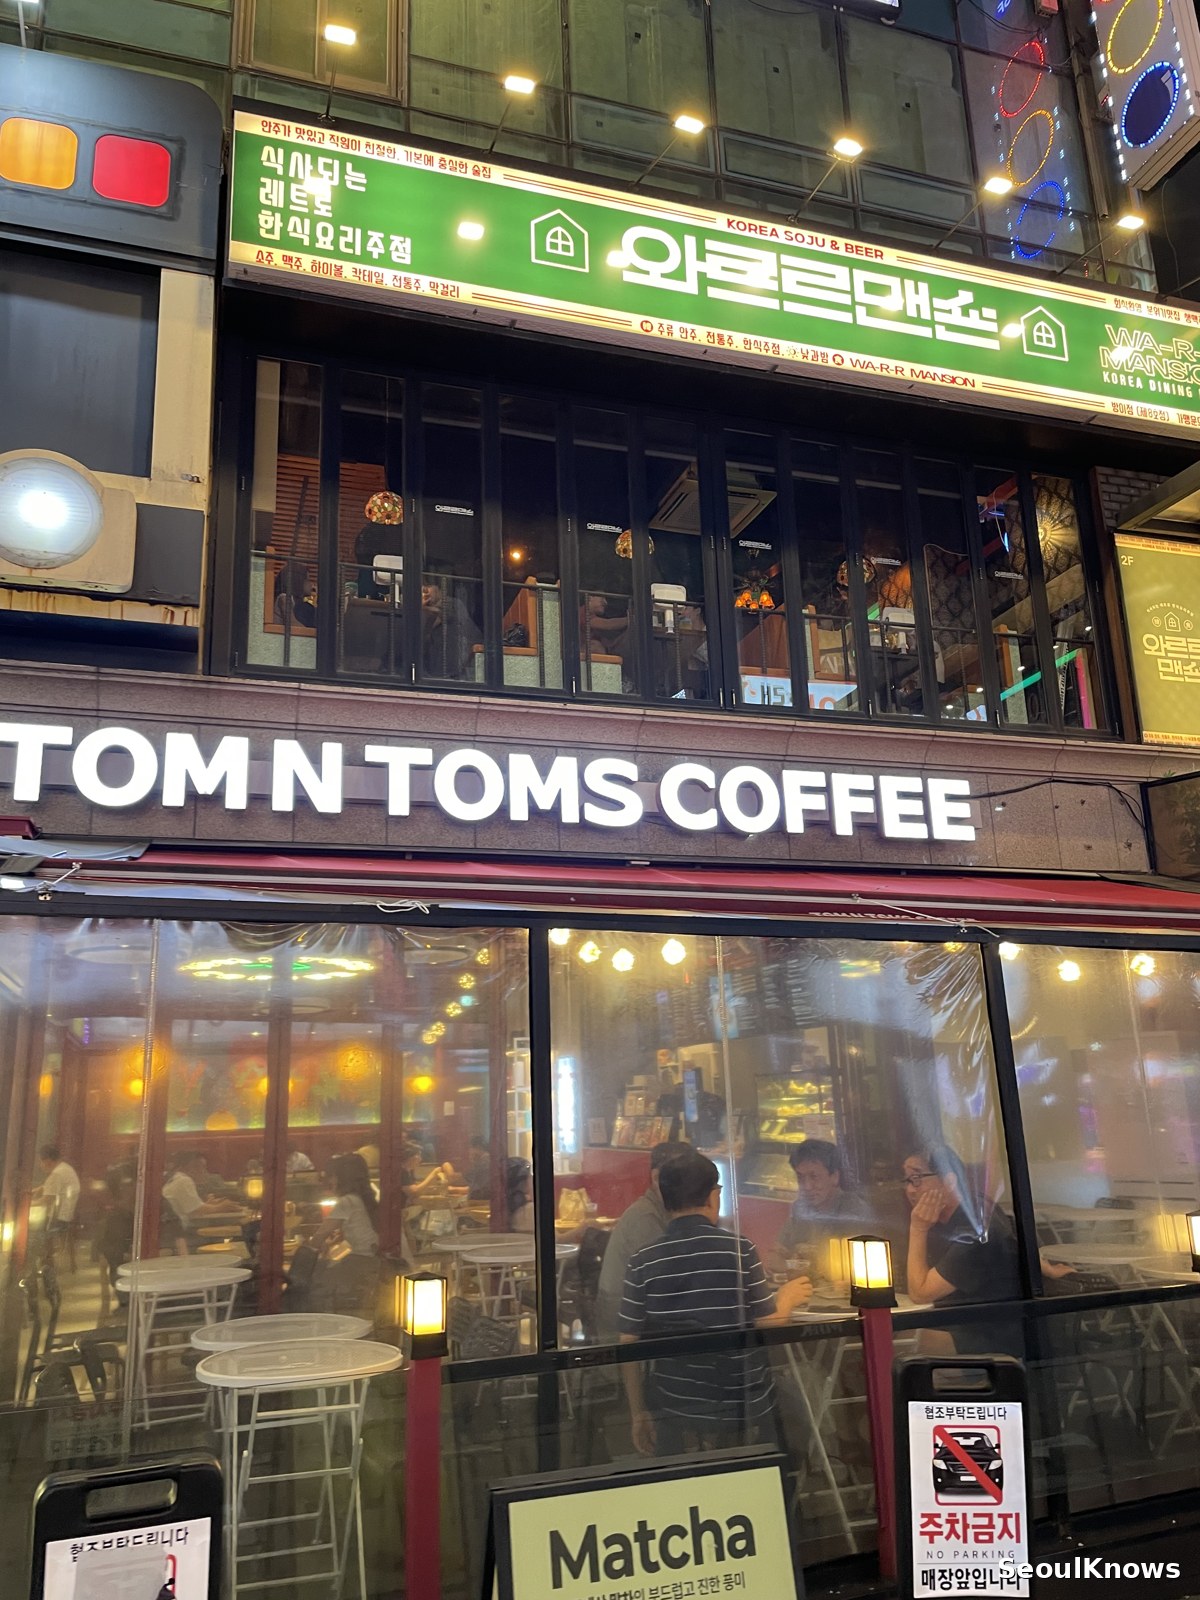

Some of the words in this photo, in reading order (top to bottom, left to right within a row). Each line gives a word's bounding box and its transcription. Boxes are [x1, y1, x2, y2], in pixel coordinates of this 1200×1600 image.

[261, 120, 291, 137] 안주가
[295, 127, 325, 144] 맛있고
[329, 133, 361, 152] 직원이
[404, 150, 434, 167] 기본에
[438, 157, 468, 174] 충실한
[472, 164, 491, 179] 술집
[261, 145, 367, 192] 식사되는
[259, 177, 332, 218] 레트로
[258, 210, 412, 265] 한식요리주점
[727, 218, 779, 239] KOREA
[784, 230, 825, 248] SOJU
[830, 240, 840, 251] &
[845, 243, 884, 260] BEER
[430, 281, 459, 298] 막걸리
[657, 323, 673, 337] 주류
[800, 347, 828, 363] 낮과밤
[849, 357, 905, 377] WA-R-R
[910, 368, 976, 388] MANSION
[1103, 371, 1143, 389] KOREA
[1149, 379, 1192, 398] DINING
[1121, 555, 1134, 566] 2F
[0, 722, 249, 811] TOM
[272, 739, 343, 814] N
[365, 745, 643, 827] TOMS
[659, 763, 976, 842] COFFEE
[924, 1406, 1007, 1420] 협조부탁드립니다
[919, 1512, 1021, 1544] 주차금지
[549, 1506, 757, 1589] Matcha
[926, 1550, 944, 1559] NO
[953, 1550, 1015, 1559] PARKING
[648, 1581, 695, 1600] 부드럽고
[698, 1575, 720, 1595] 진한
[723, 1571, 746, 1591] 풍미
